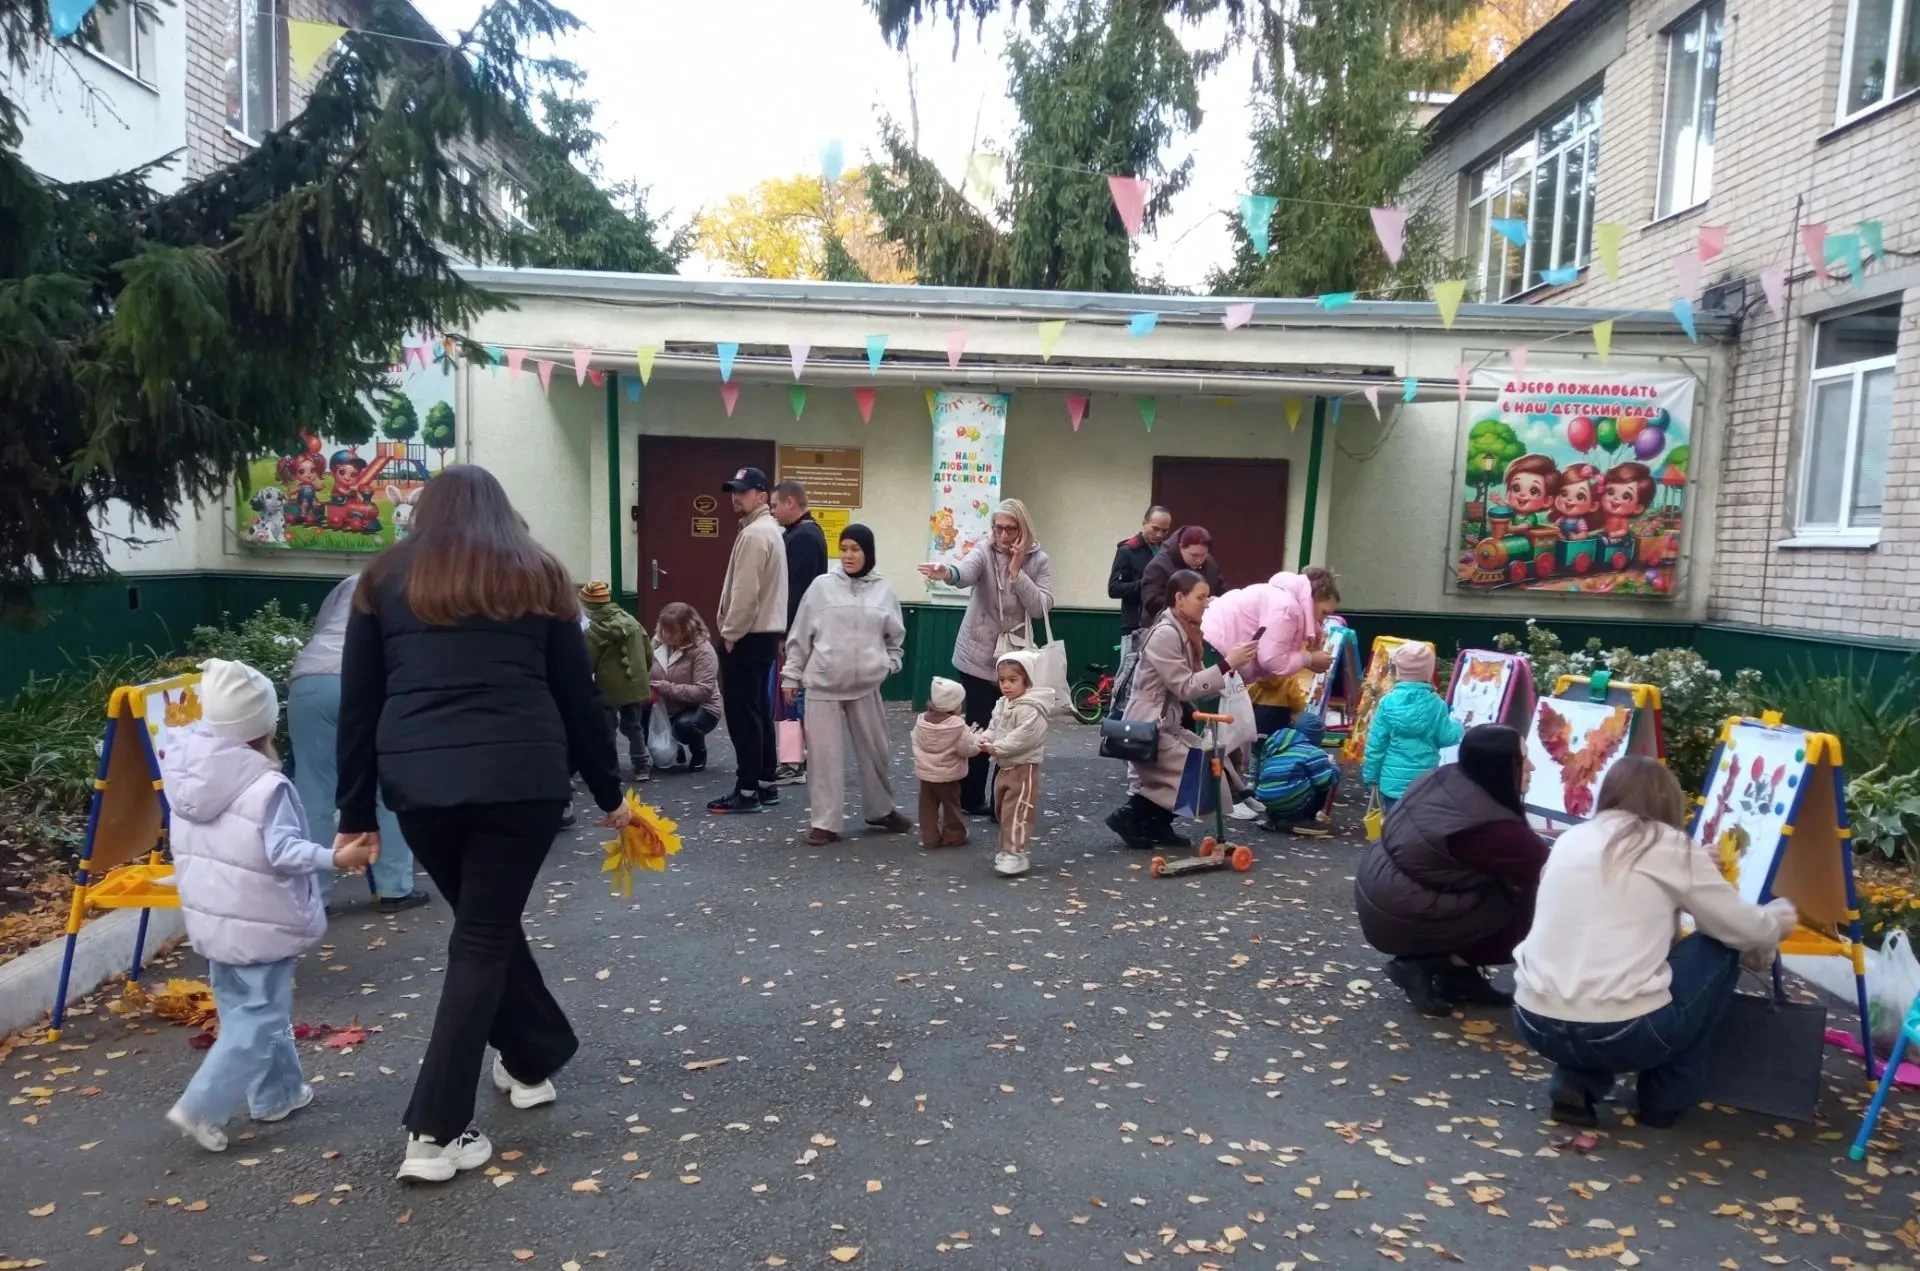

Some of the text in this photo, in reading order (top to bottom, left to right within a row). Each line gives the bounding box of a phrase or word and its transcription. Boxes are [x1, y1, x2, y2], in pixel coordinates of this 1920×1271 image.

[1557, 382, 1658, 398] ПОЖАЛОВАТЬ
[1514, 402, 1547, 414] НАШ
[1550, 403, 1622, 416] ДЕТСКИЙ
[1624, 406, 1660, 418] САД!
[955, 451, 977, 460] НАШ
[939, 461, 992, 472] ЛЮБИМЫЙ
[933, 472, 998, 486] ДЕТСКИЙ САД
